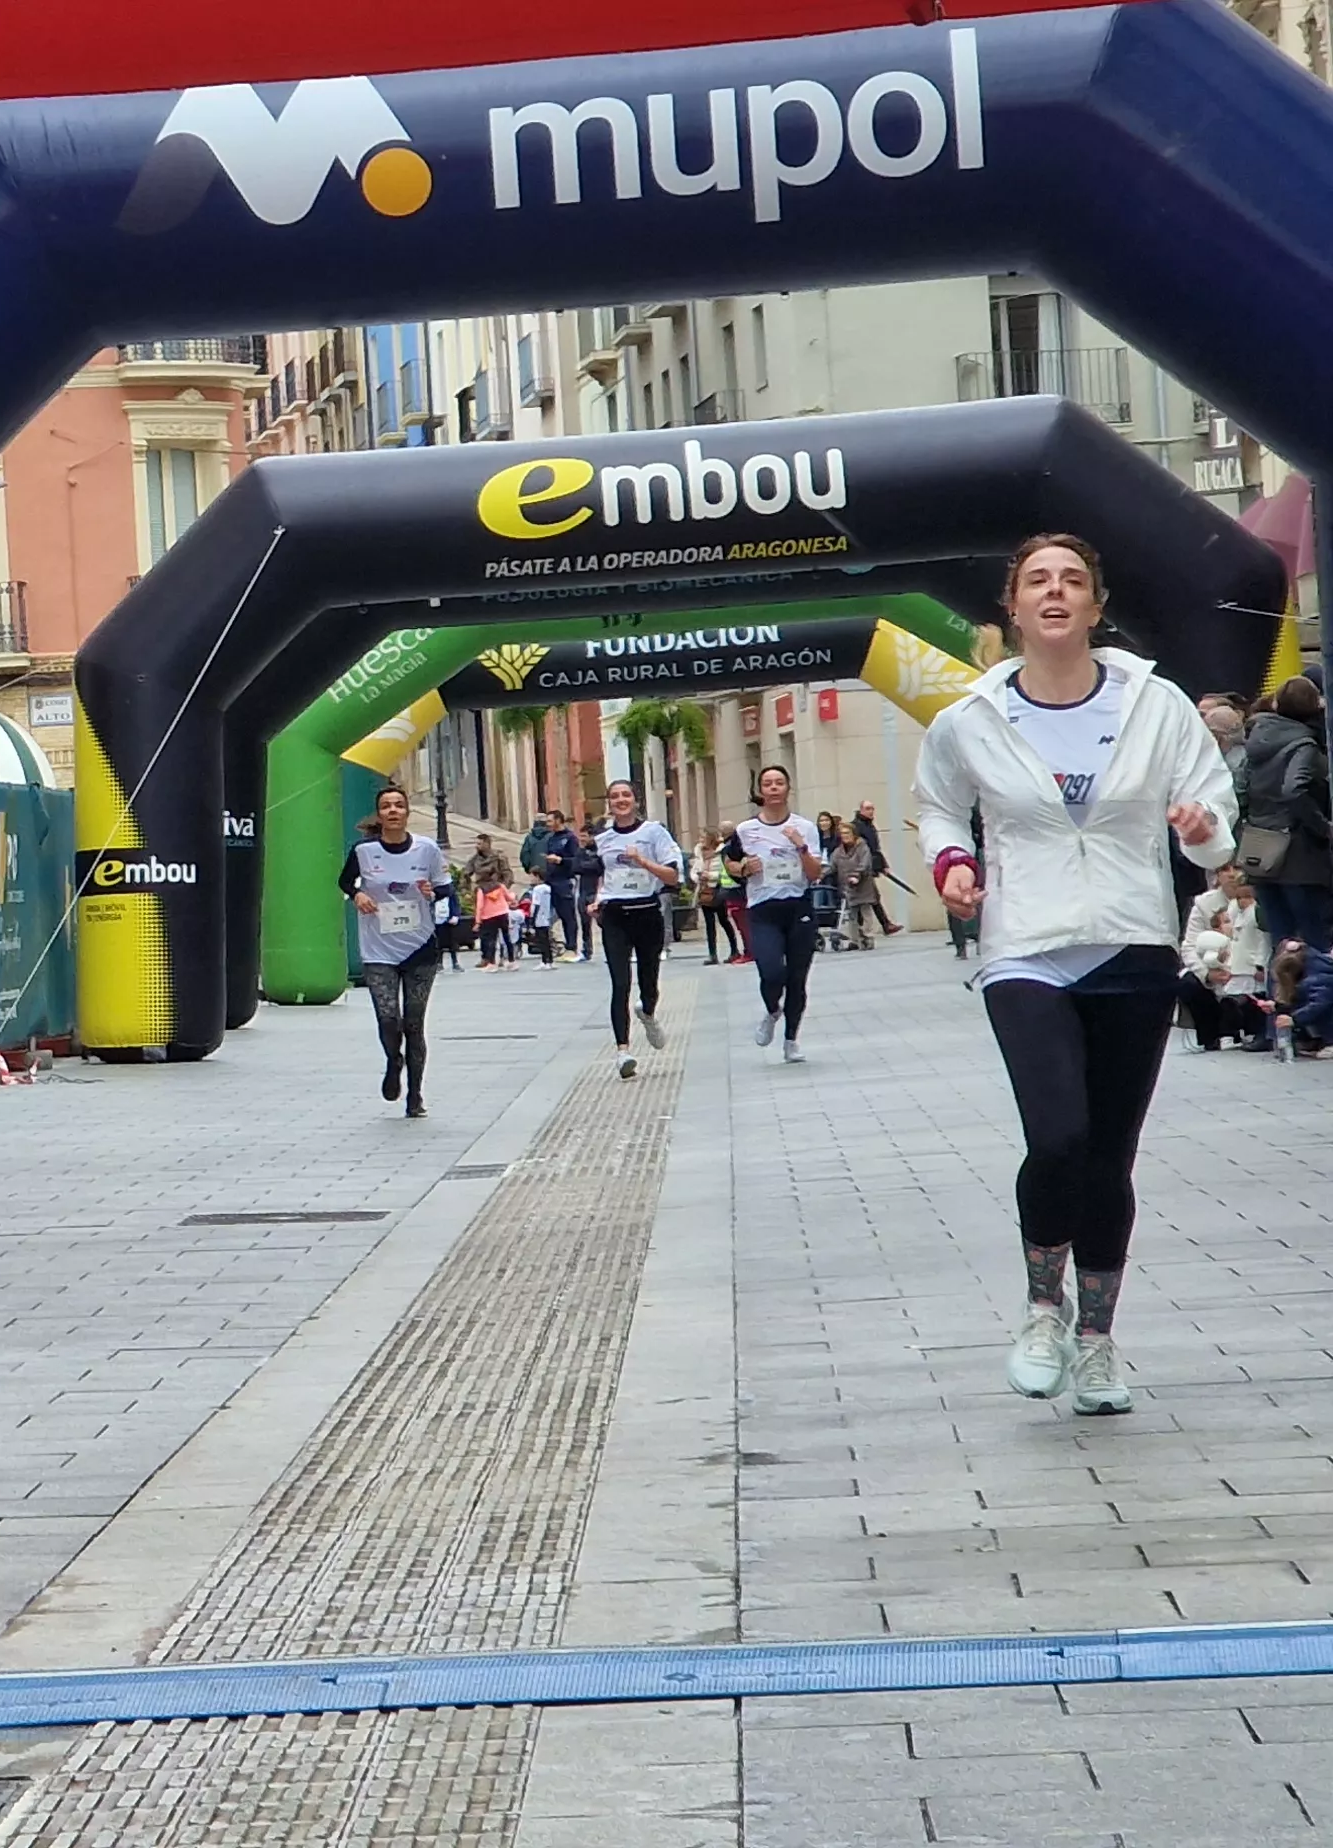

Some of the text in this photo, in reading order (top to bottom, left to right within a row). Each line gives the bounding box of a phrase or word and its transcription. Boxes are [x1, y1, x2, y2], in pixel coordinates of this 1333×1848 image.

[490, 28, 985, 223] mupol
[477, 439, 847, 540] embou
[484, 535, 849, 579] PÁSATE A LA OPERADORA ARAGONESA
[538, 648, 833, 688] CAJA RURAL DE ARAGÓN
[36, 712, 71, 721] ALTO
[93, 855, 197, 887] embou
